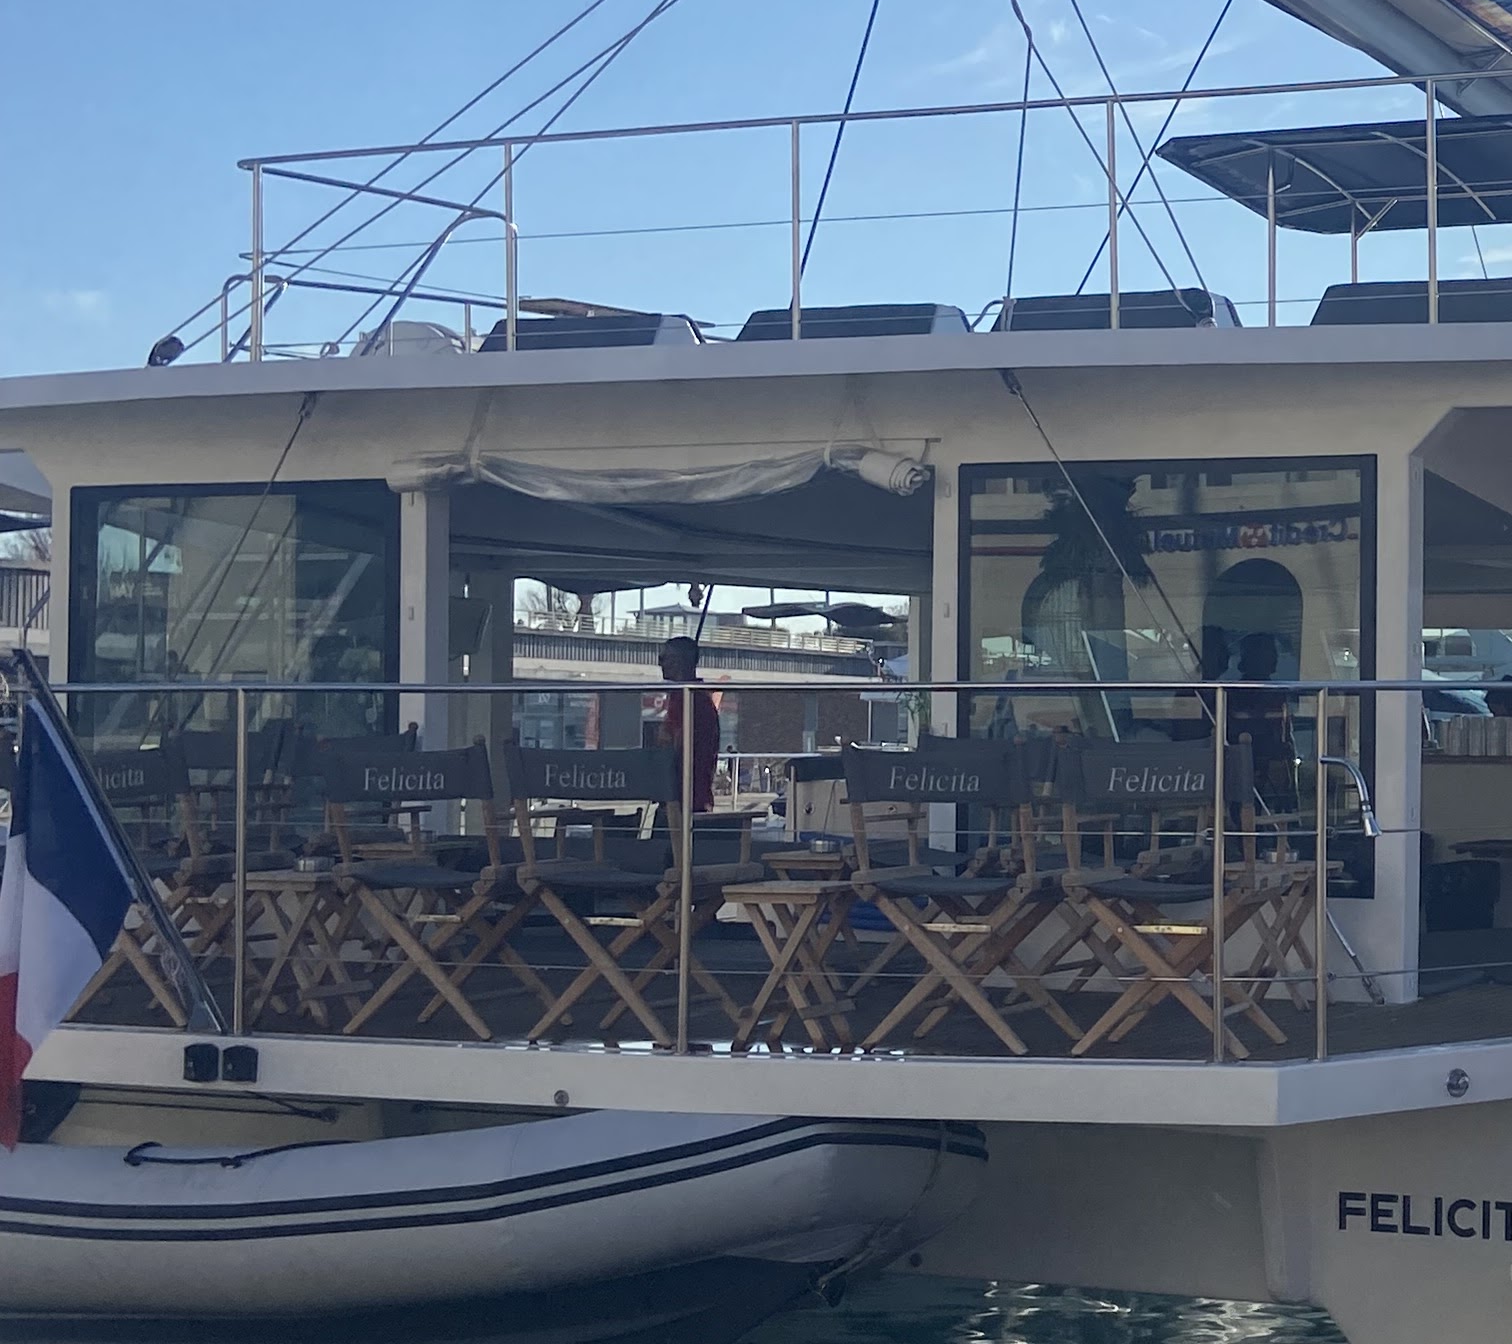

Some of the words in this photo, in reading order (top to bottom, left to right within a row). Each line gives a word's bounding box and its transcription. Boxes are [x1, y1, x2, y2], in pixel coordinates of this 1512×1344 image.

[364, 765, 445, 792] Felicita
[544, 763, 627, 790] Felicita
[888, 765, 981, 793] Felicita
[1107, 766, 1206, 793] Felicita
